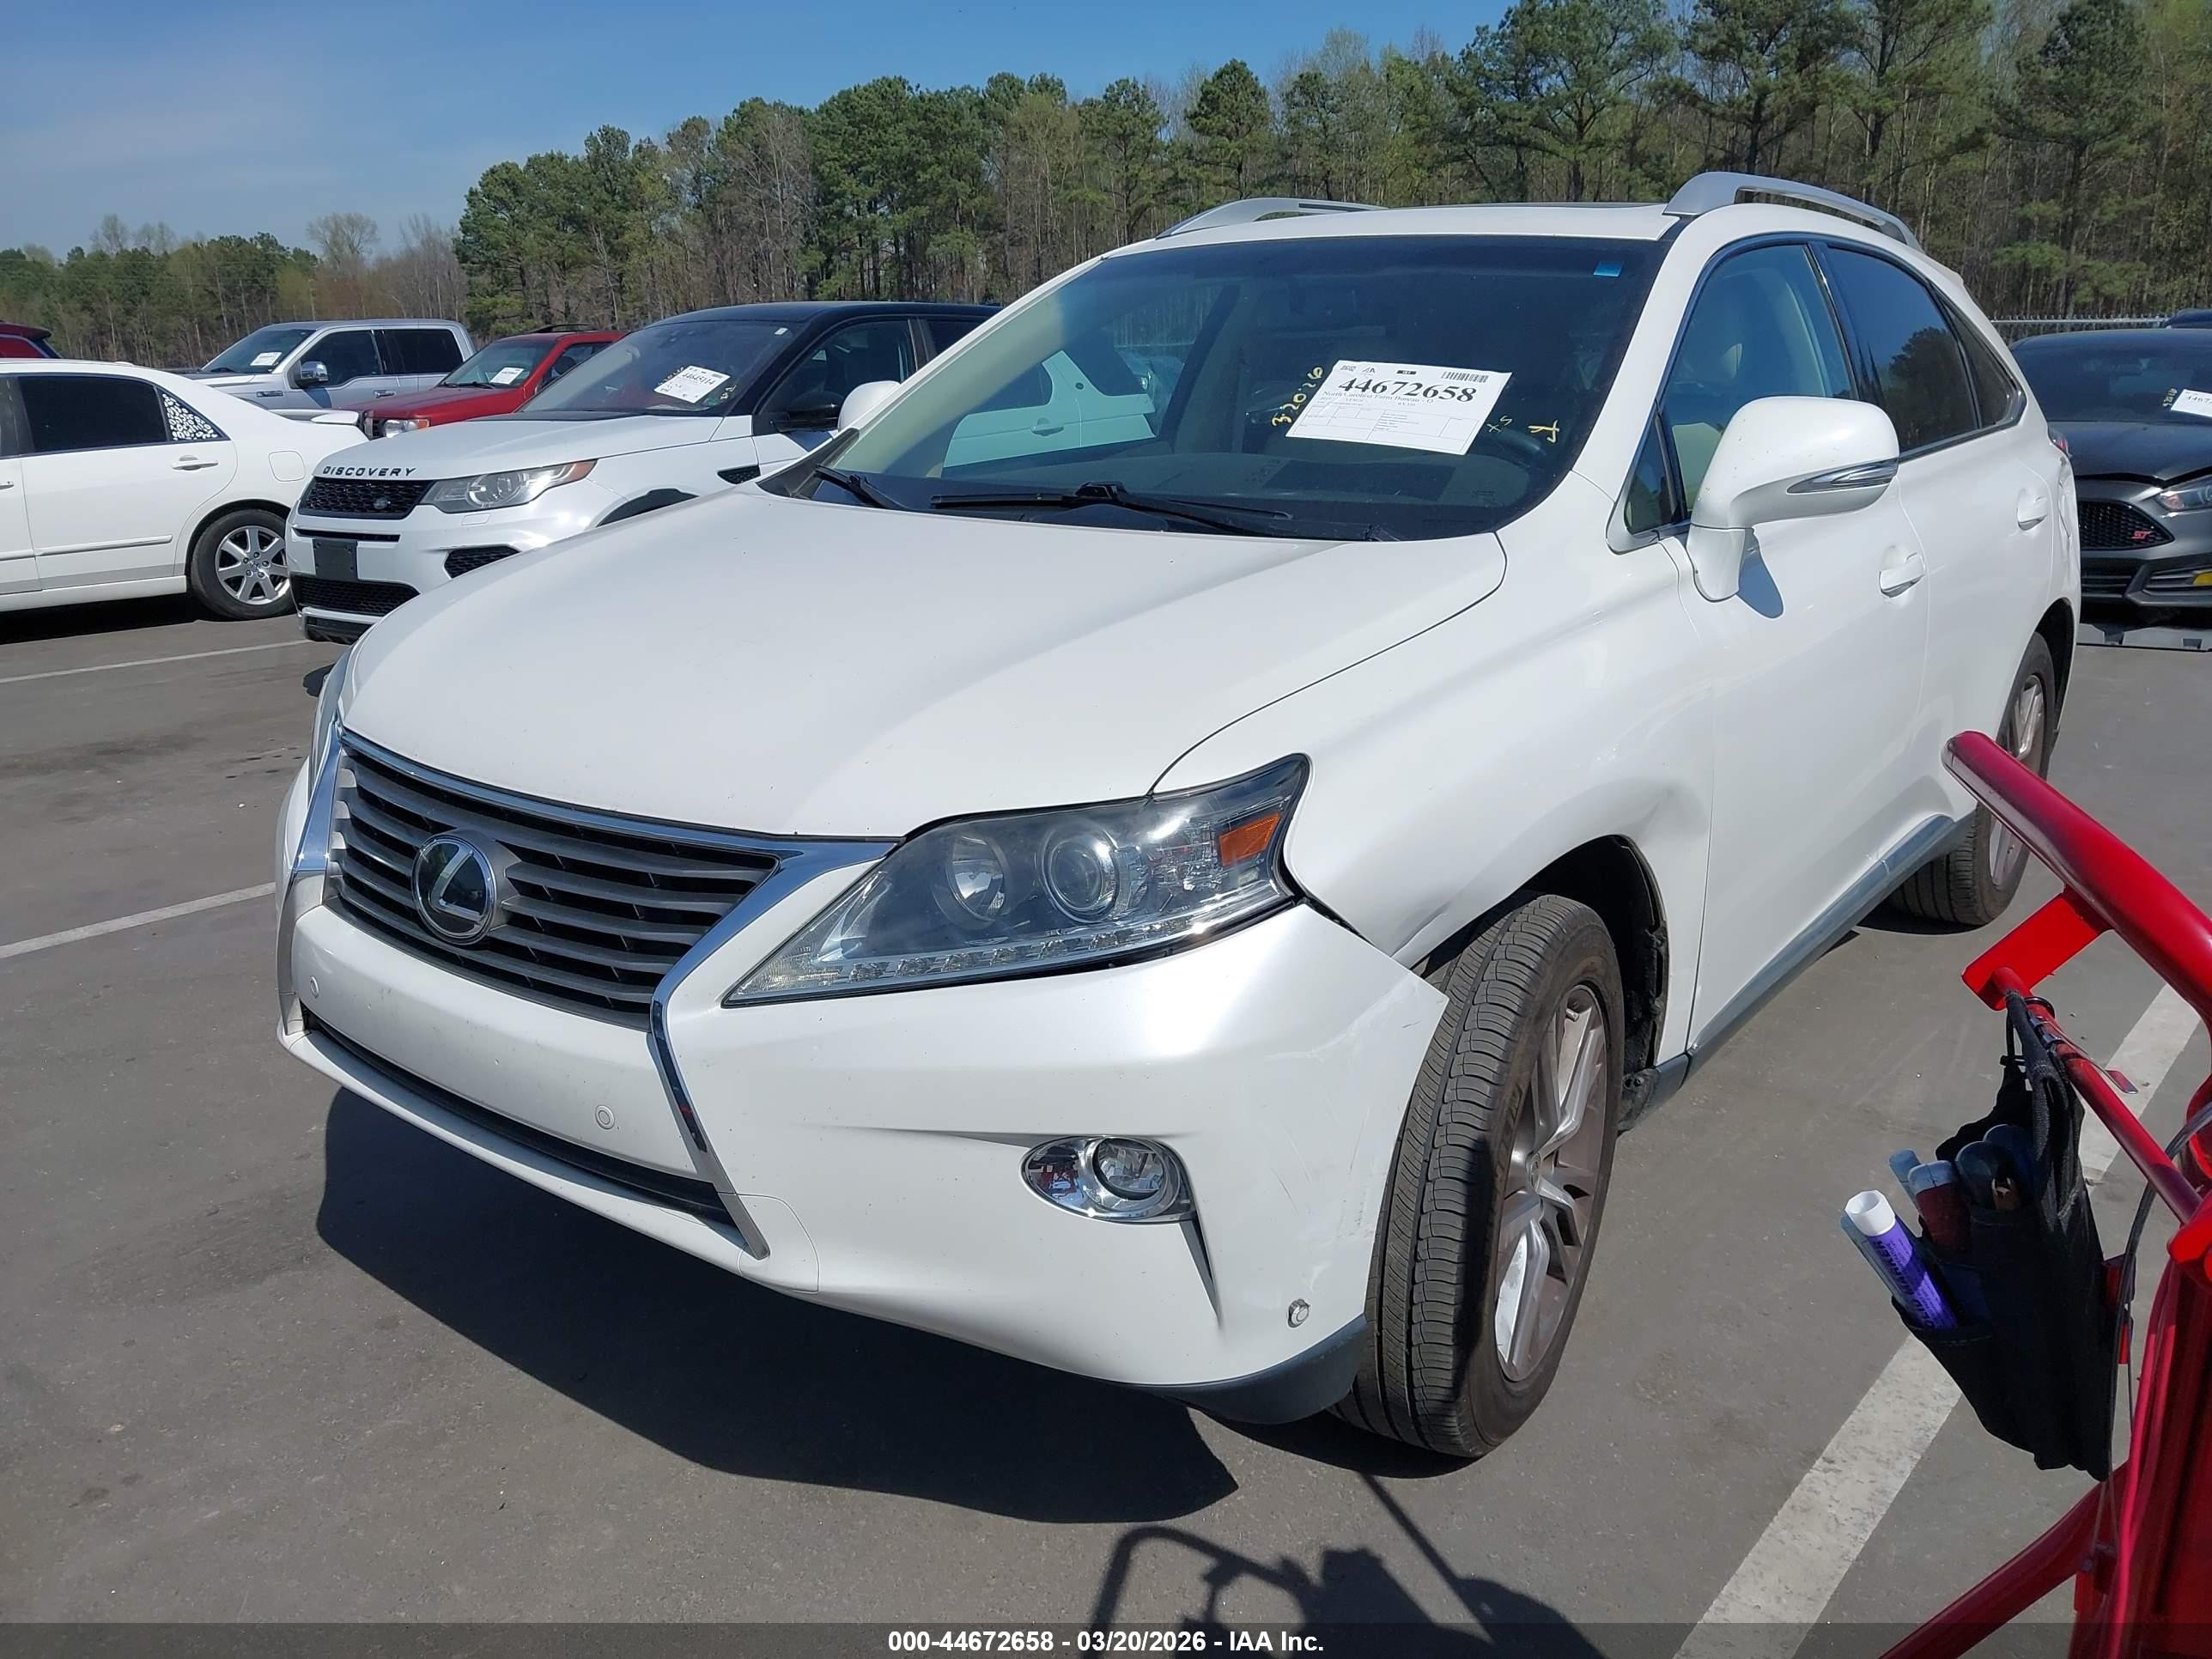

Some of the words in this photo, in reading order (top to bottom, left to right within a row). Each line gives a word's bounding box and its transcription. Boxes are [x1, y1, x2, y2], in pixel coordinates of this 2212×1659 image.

[1338, 378, 1477, 403] 44672658
[322, 465, 416, 477] DISCOVERY
[1872, 1240, 1915, 1296] MARKER
